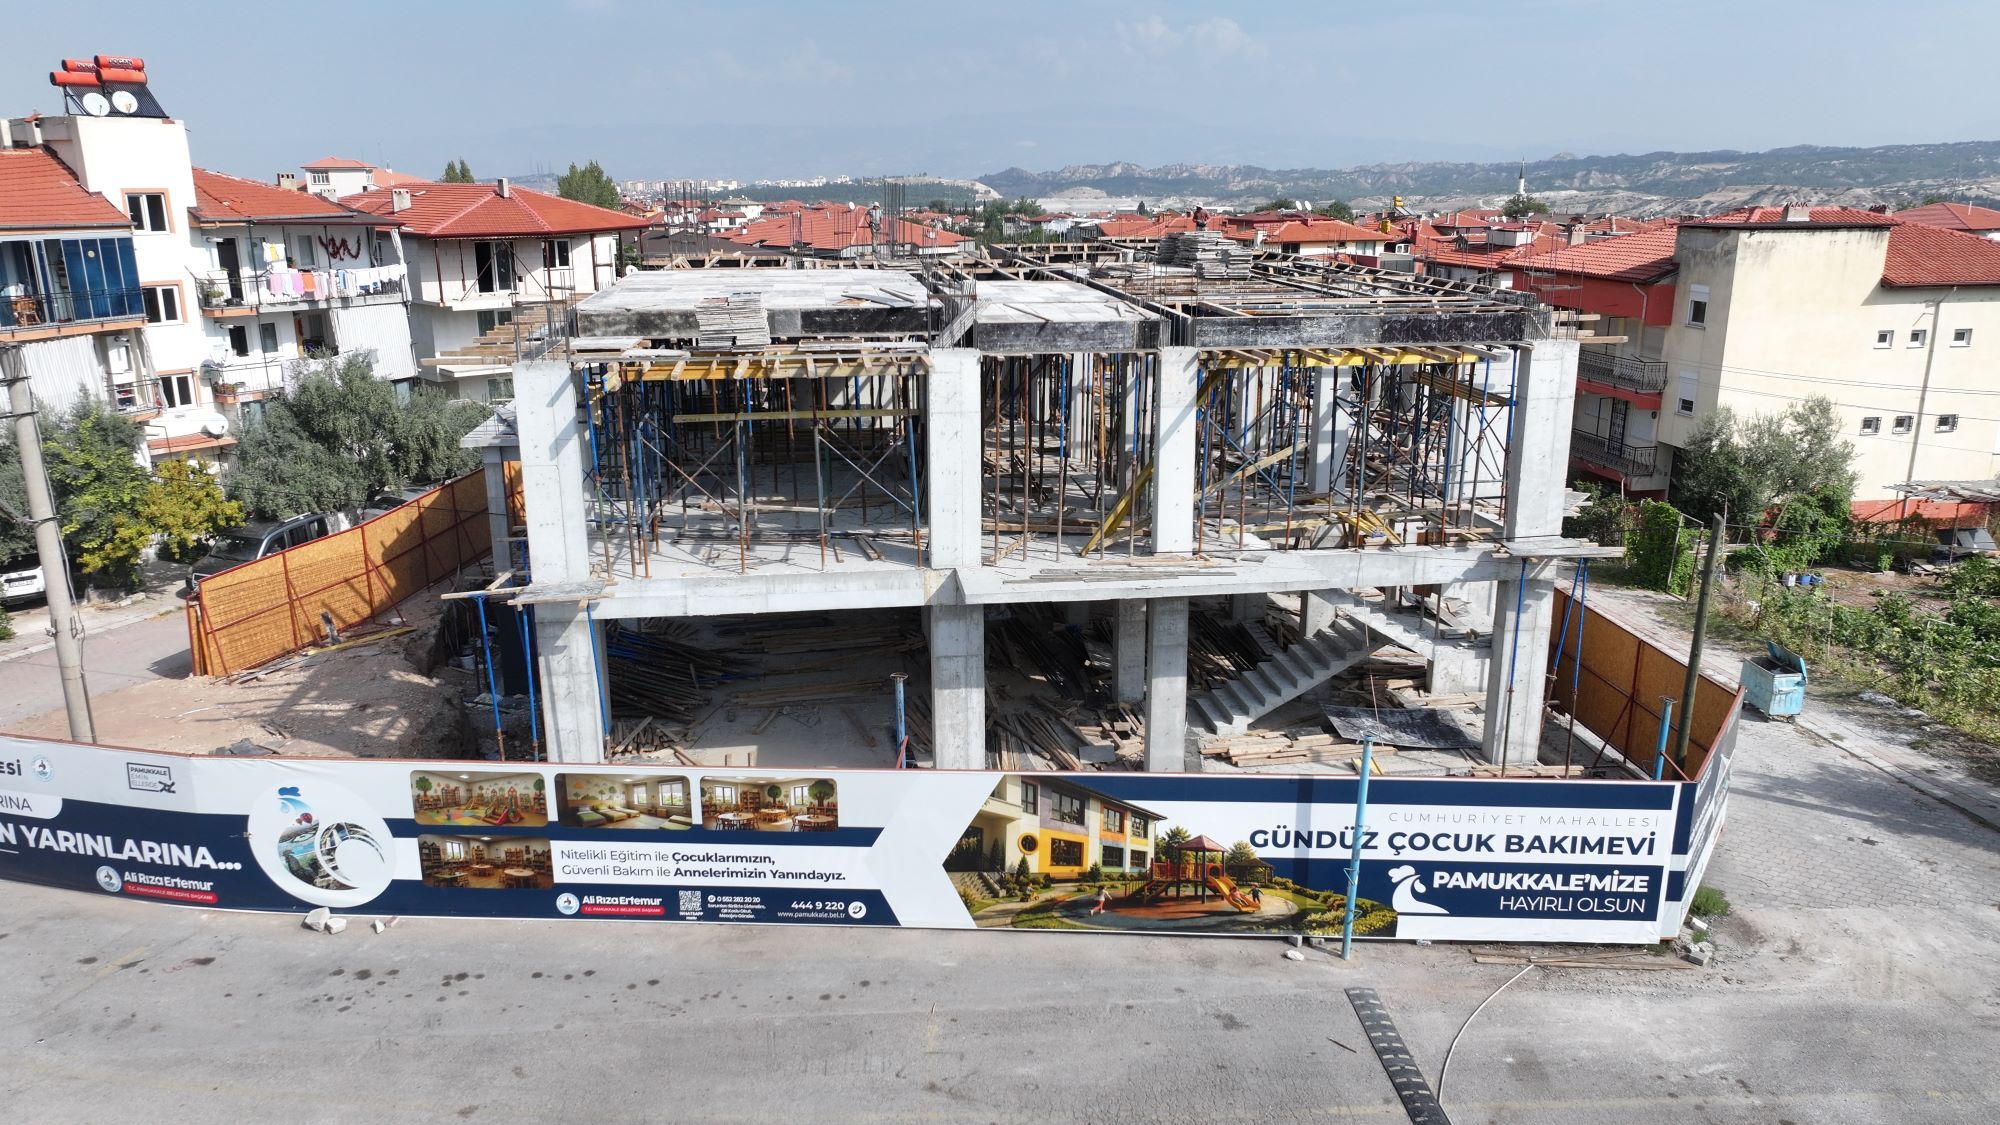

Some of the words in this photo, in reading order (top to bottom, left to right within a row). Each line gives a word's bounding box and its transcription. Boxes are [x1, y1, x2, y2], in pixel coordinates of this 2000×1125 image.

[130, 766, 168, 776] PAMUKKALE
[1388, 812, 1527, 825] CUMHURİYET
[1539, 815, 1660, 827] MAHALLESİ
[19, 824, 242, 870] YARINLARINA...
[1250, 824, 1379, 850] GÜNDÜZ
[1387, 831, 1496, 856] ÇOCUK
[1504, 831, 1656, 856] BAKIMEVİ
[560, 849, 607, 860] Nitelikli
[610, 850, 652, 863] Eğitim
[654, 851, 669, 861] ile
[671, 851, 776, 865] Çocuklarımızın,
[124, 871, 137, 882] Ali
[138, 873, 164, 886] Rıza
[165, 876, 213, 891] Ertemur
[562, 864, 609, 875] Güvenli
[613, 866, 654, 876] Bakım
[656, 866, 671, 877] ile
[673, 867, 767, 879] Annelerimizin
[769, 869, 846, 883] Yanındayız.
[1432, 869, 1650, 893] PAMUKKALE'MİZE
[582, 896, 595, 904] Ali
[596, 896, 619, 905] Rıza
[620, 896, 662, 906] Ertemur
[791, 901, 813, 910] 444
[815, 901, 823, 910] 9
[824, 902, 845, 910] 220
[1500, 896, 1574, 911] HAYIRLI
[1577, 897, 1646, 913] OLSUN
[777, 911, 846, 919] www.pamukkale.bel.tr
